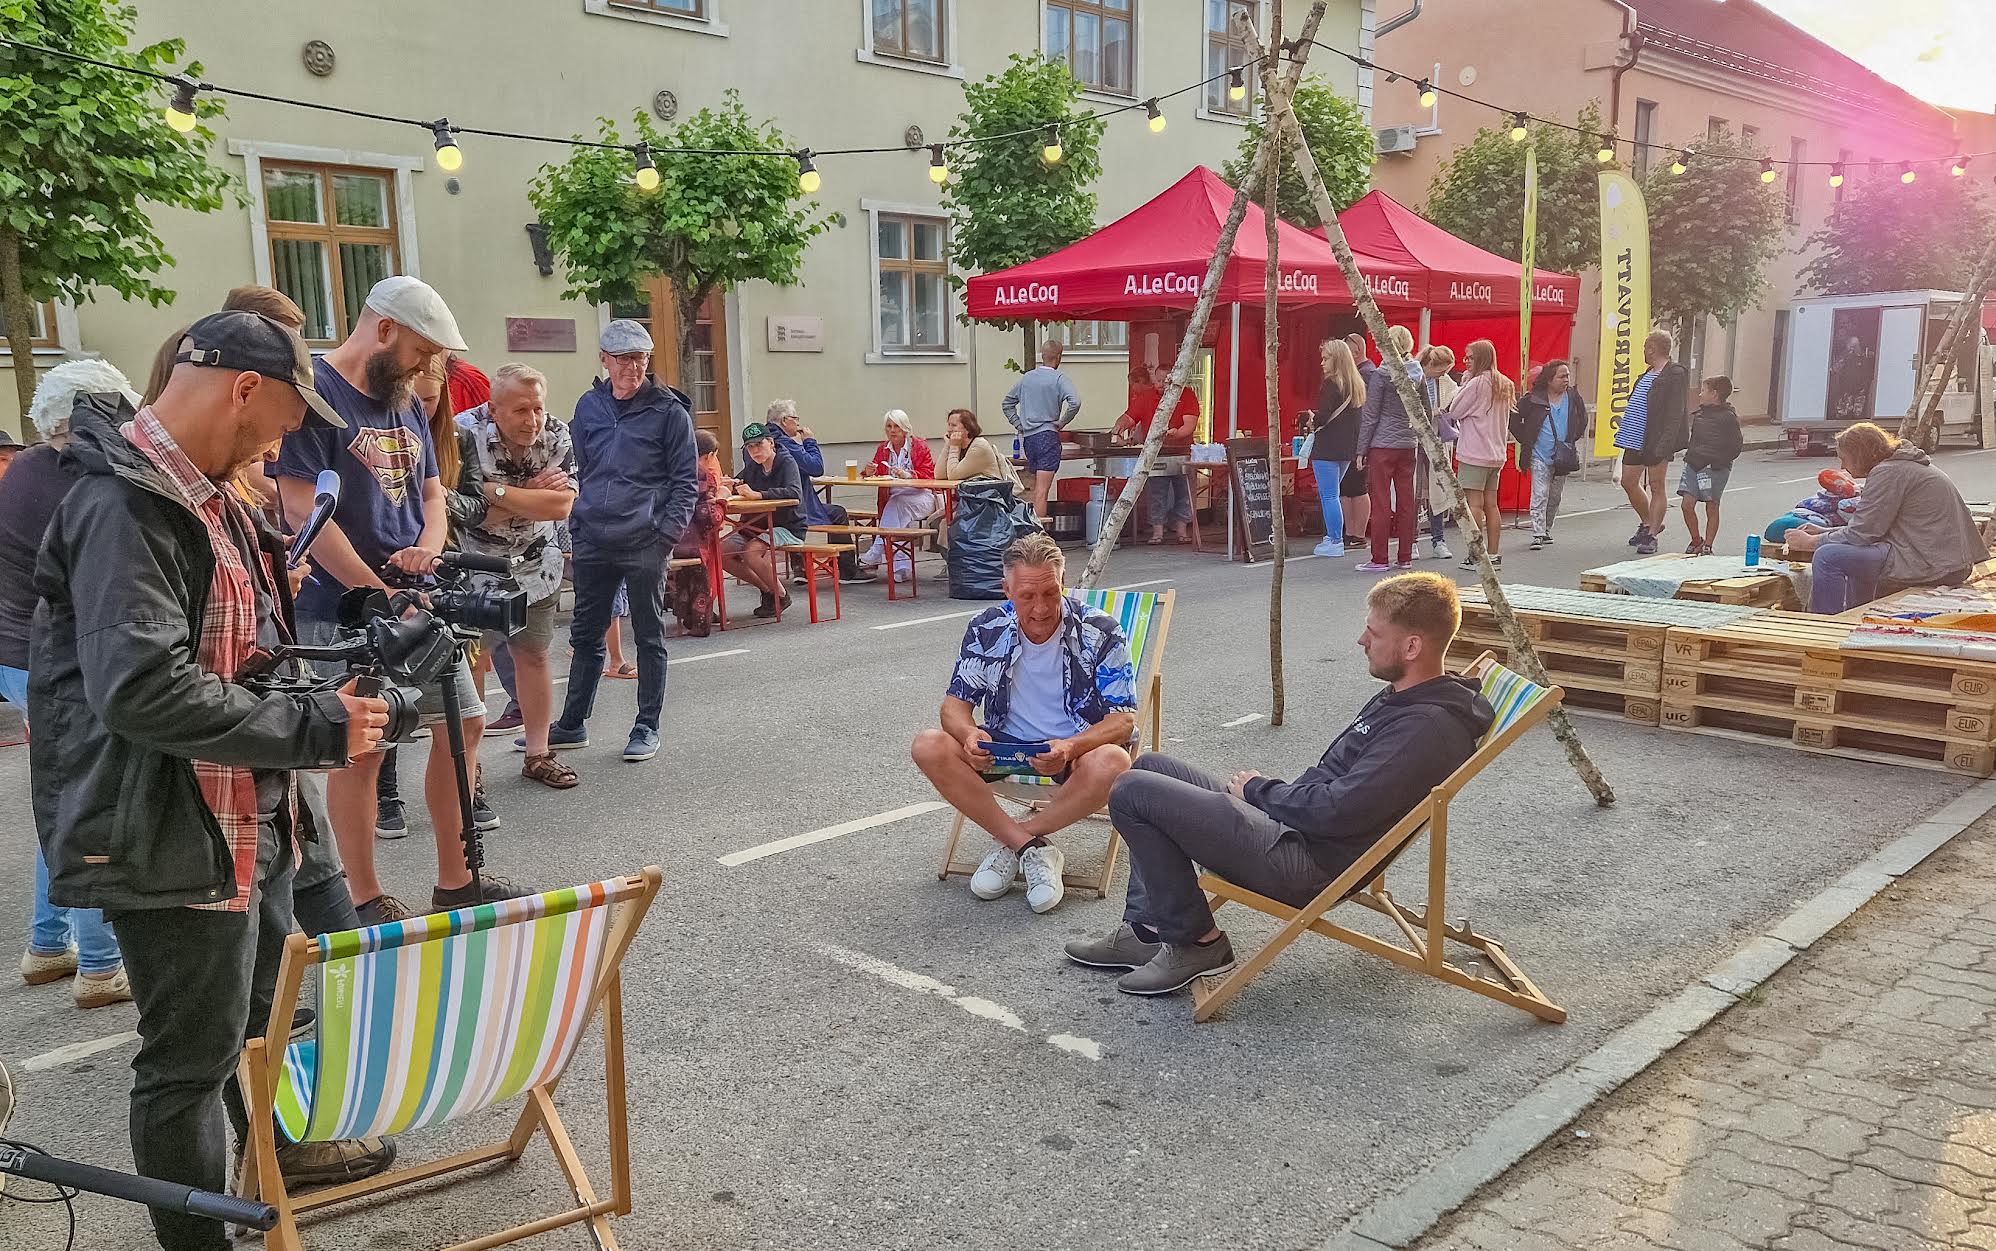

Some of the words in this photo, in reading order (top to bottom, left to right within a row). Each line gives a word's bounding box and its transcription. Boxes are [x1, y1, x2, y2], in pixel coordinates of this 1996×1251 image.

[994, 282, 1059, 305] A.LeCoq
[1123, 271, 1200, 298] A.LeCoq
[1264, 269, 1319, 296] LeCoq
[1531, 284, 1565, 307] .LeCoq
[1674, 642, 1693, 656] VR
[1963, 681, 1983, 694] EUR
[1958, 718, 1978, 730] EUR
